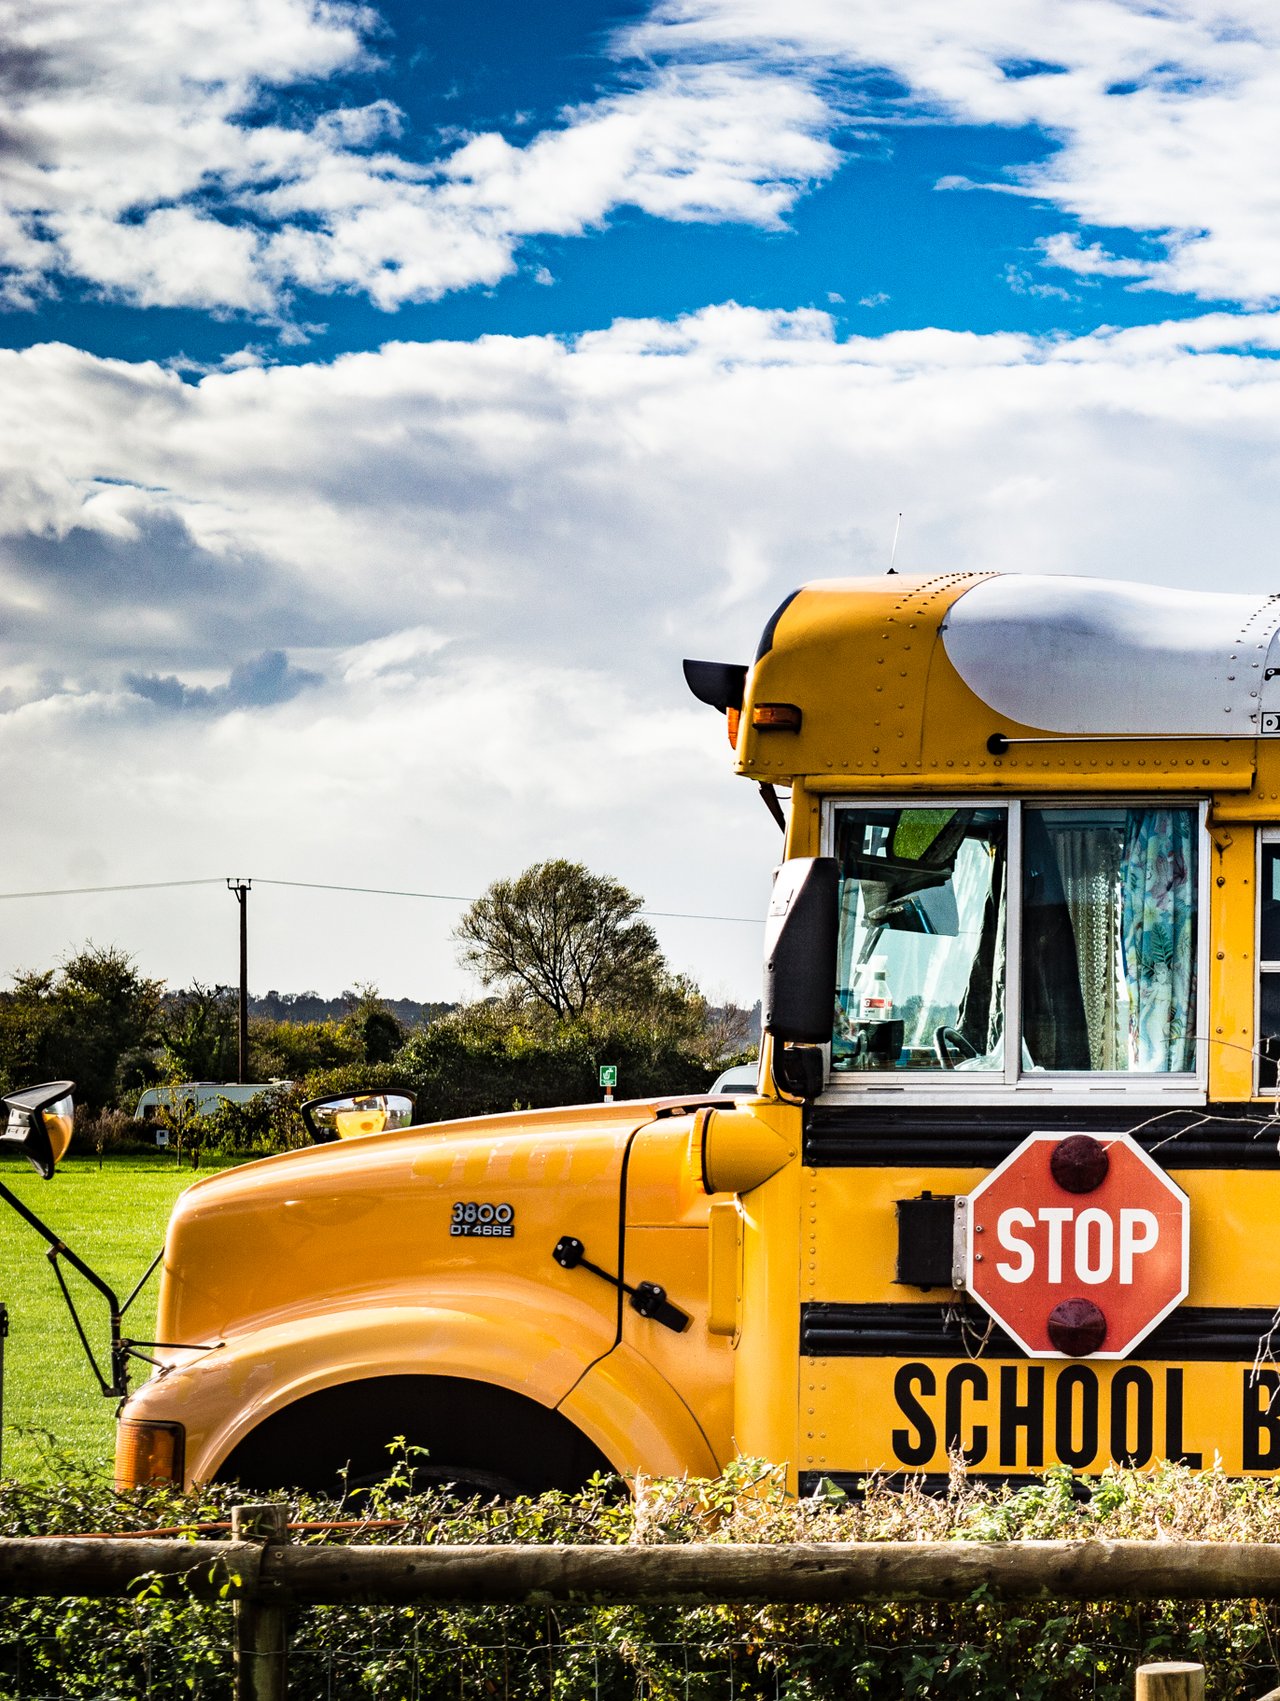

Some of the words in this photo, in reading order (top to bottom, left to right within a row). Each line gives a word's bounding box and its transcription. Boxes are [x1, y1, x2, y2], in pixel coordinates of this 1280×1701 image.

[452, 1203, 513, 1223] 3800
[996, 1207, 1160, 1285] STOP
[891, 1362, 1203, 1469] SCHOOL
